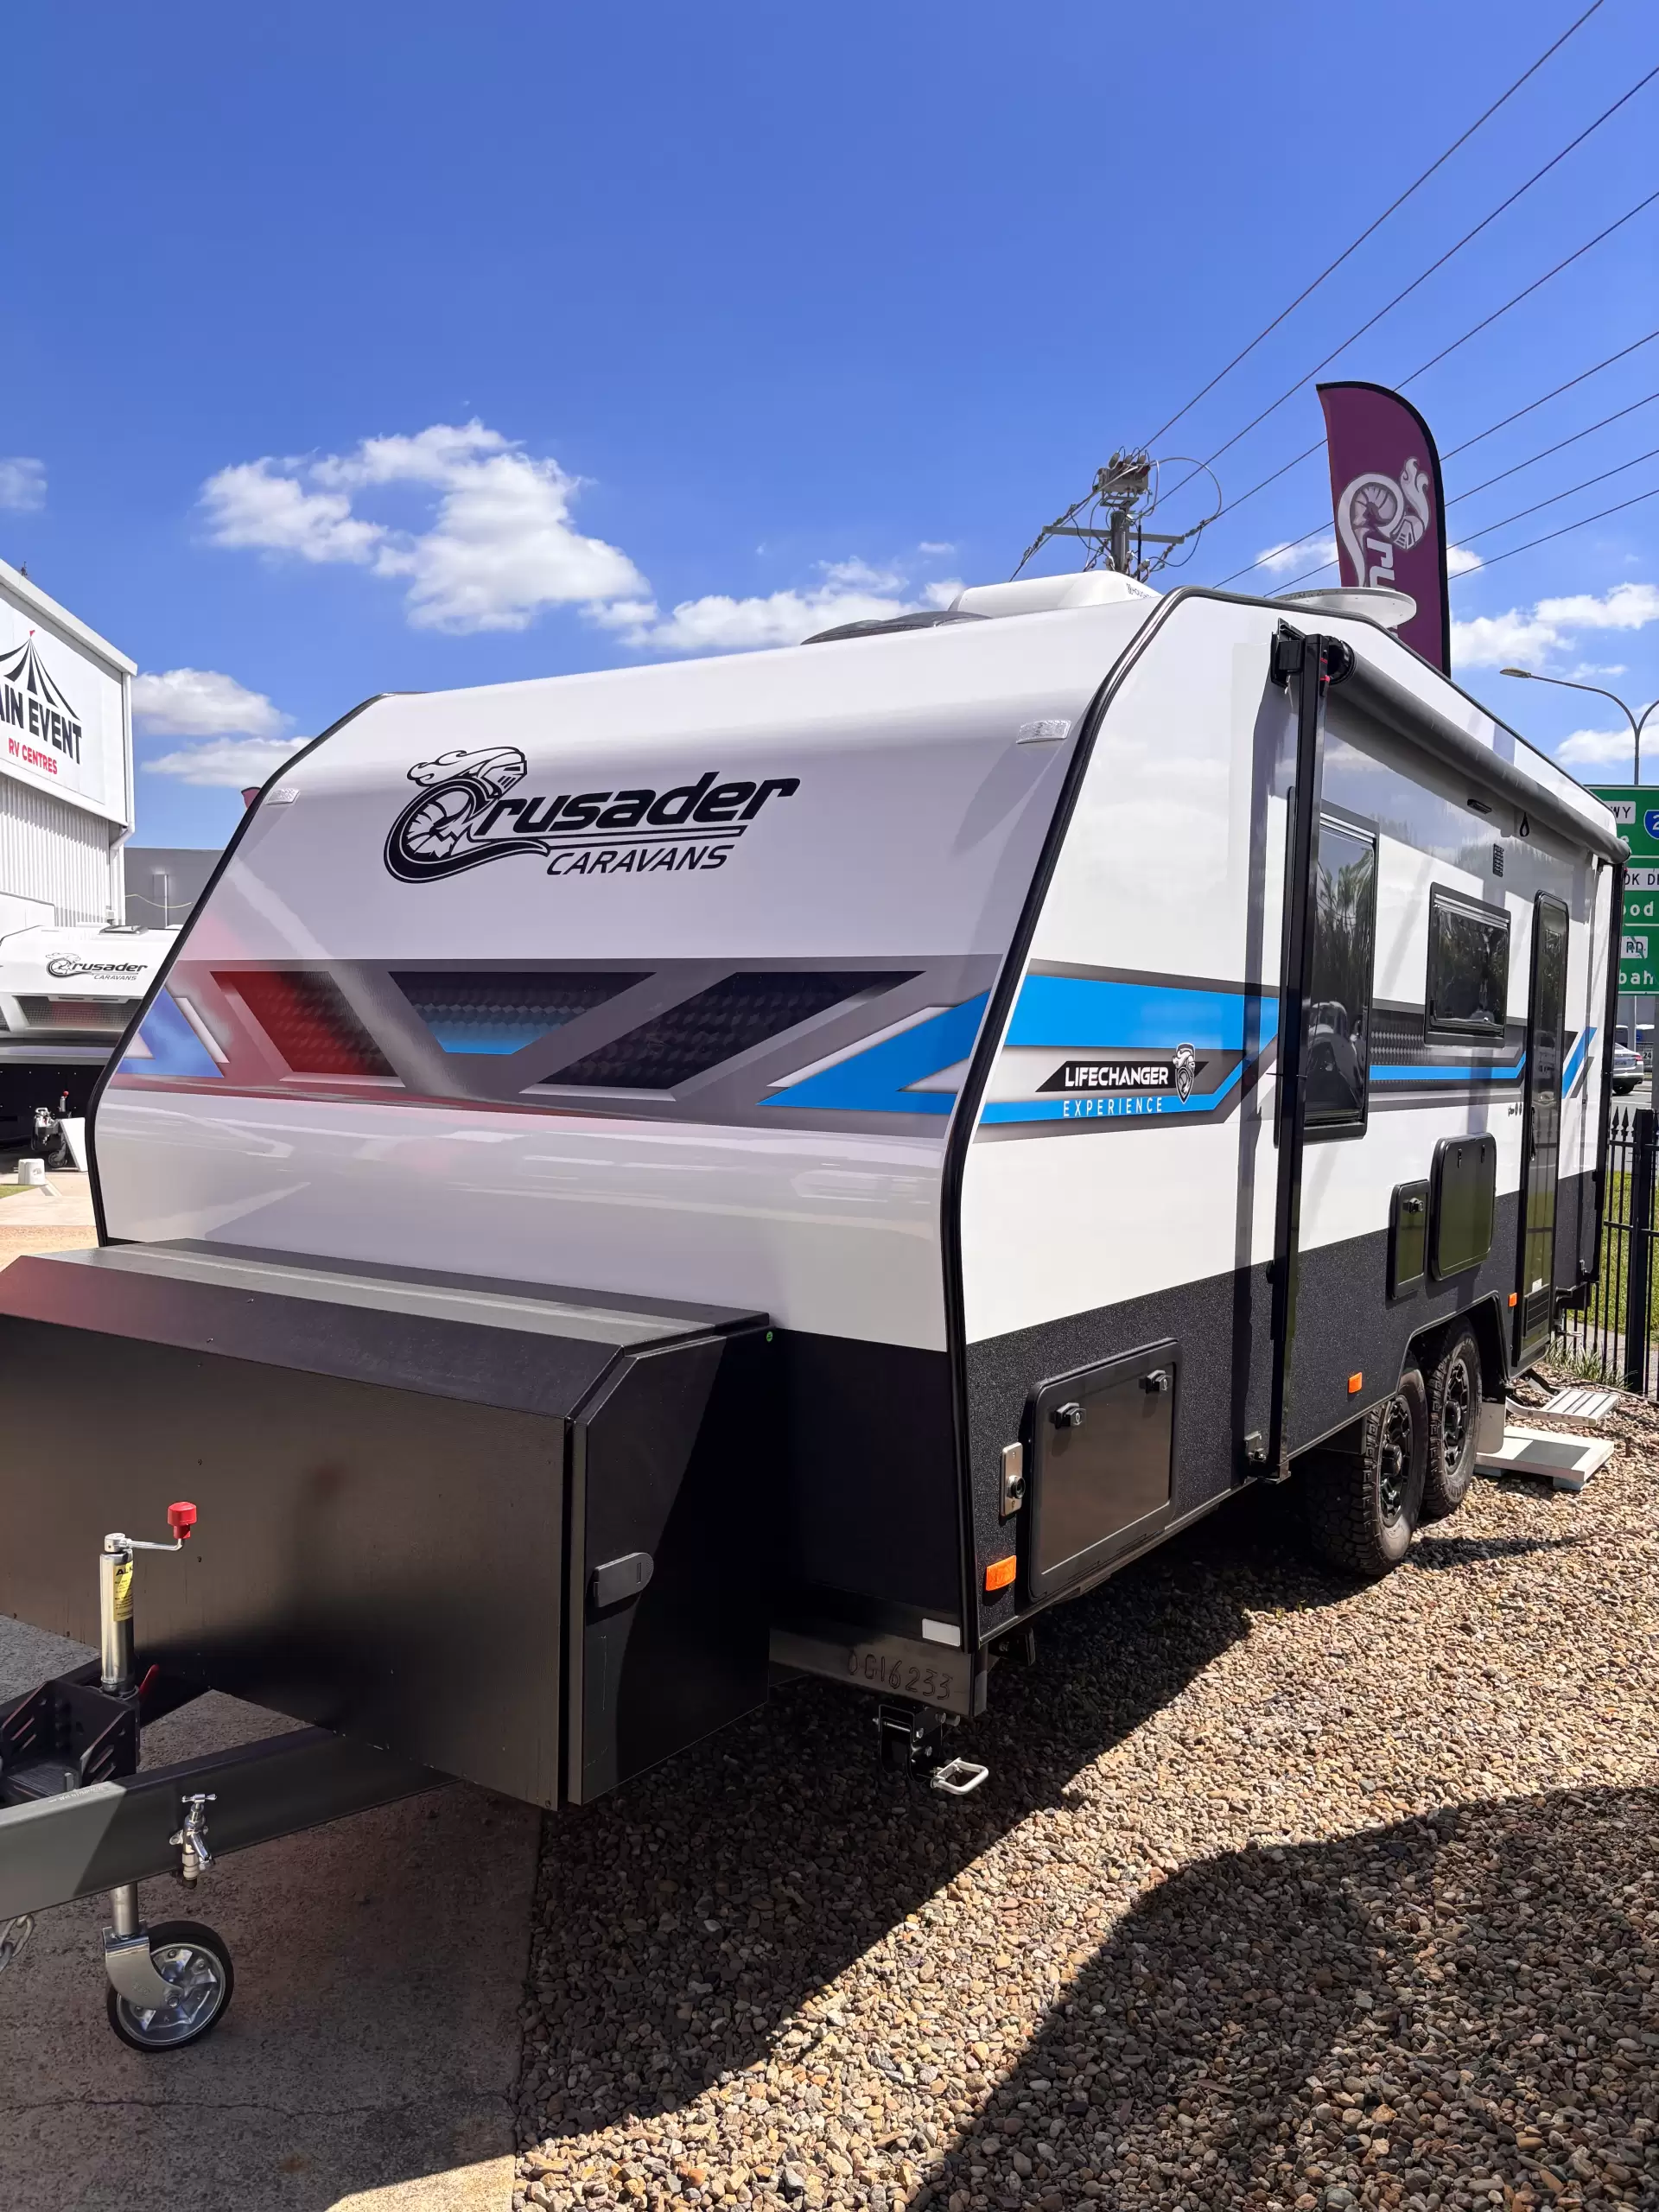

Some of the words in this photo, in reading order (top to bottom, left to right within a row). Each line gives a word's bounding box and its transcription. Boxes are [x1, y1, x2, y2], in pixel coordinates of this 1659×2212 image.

[29, 697, 82, 765] EVENT
[9, 737, 19, 757] RV
[22, 745, 58, 774] CENTRES
[546, 844, 735, 875] CARAVANS
[1065, 1066, 1168, 1087] LIFECHANGER
[1064, 1097, 1162, 1116] EXPERIENCE
